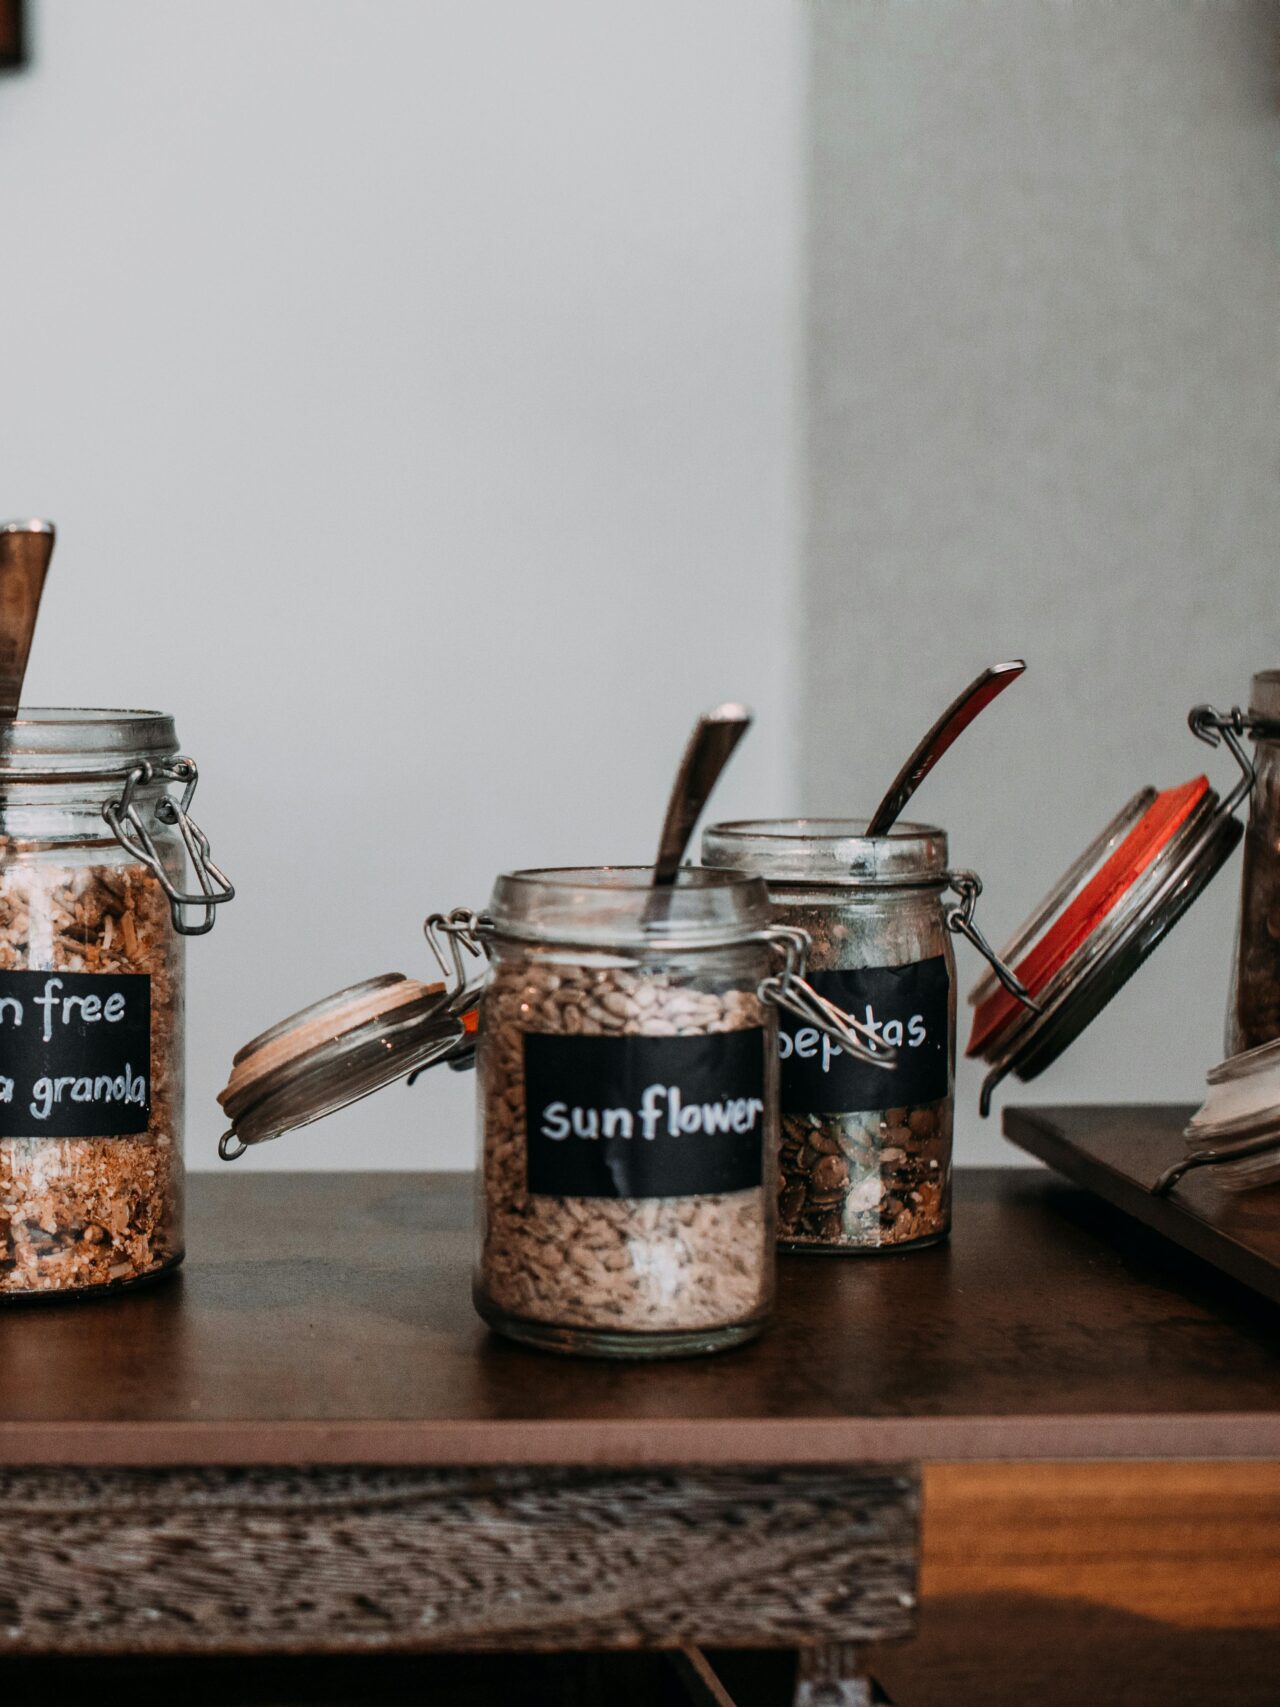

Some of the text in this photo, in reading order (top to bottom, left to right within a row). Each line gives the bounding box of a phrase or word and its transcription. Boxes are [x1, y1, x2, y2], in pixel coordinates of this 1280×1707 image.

[33, 977, 126, 1043] free
[29, 1062, 147, 1120] granola
[541, 1083, 764, 1141] sunflower
